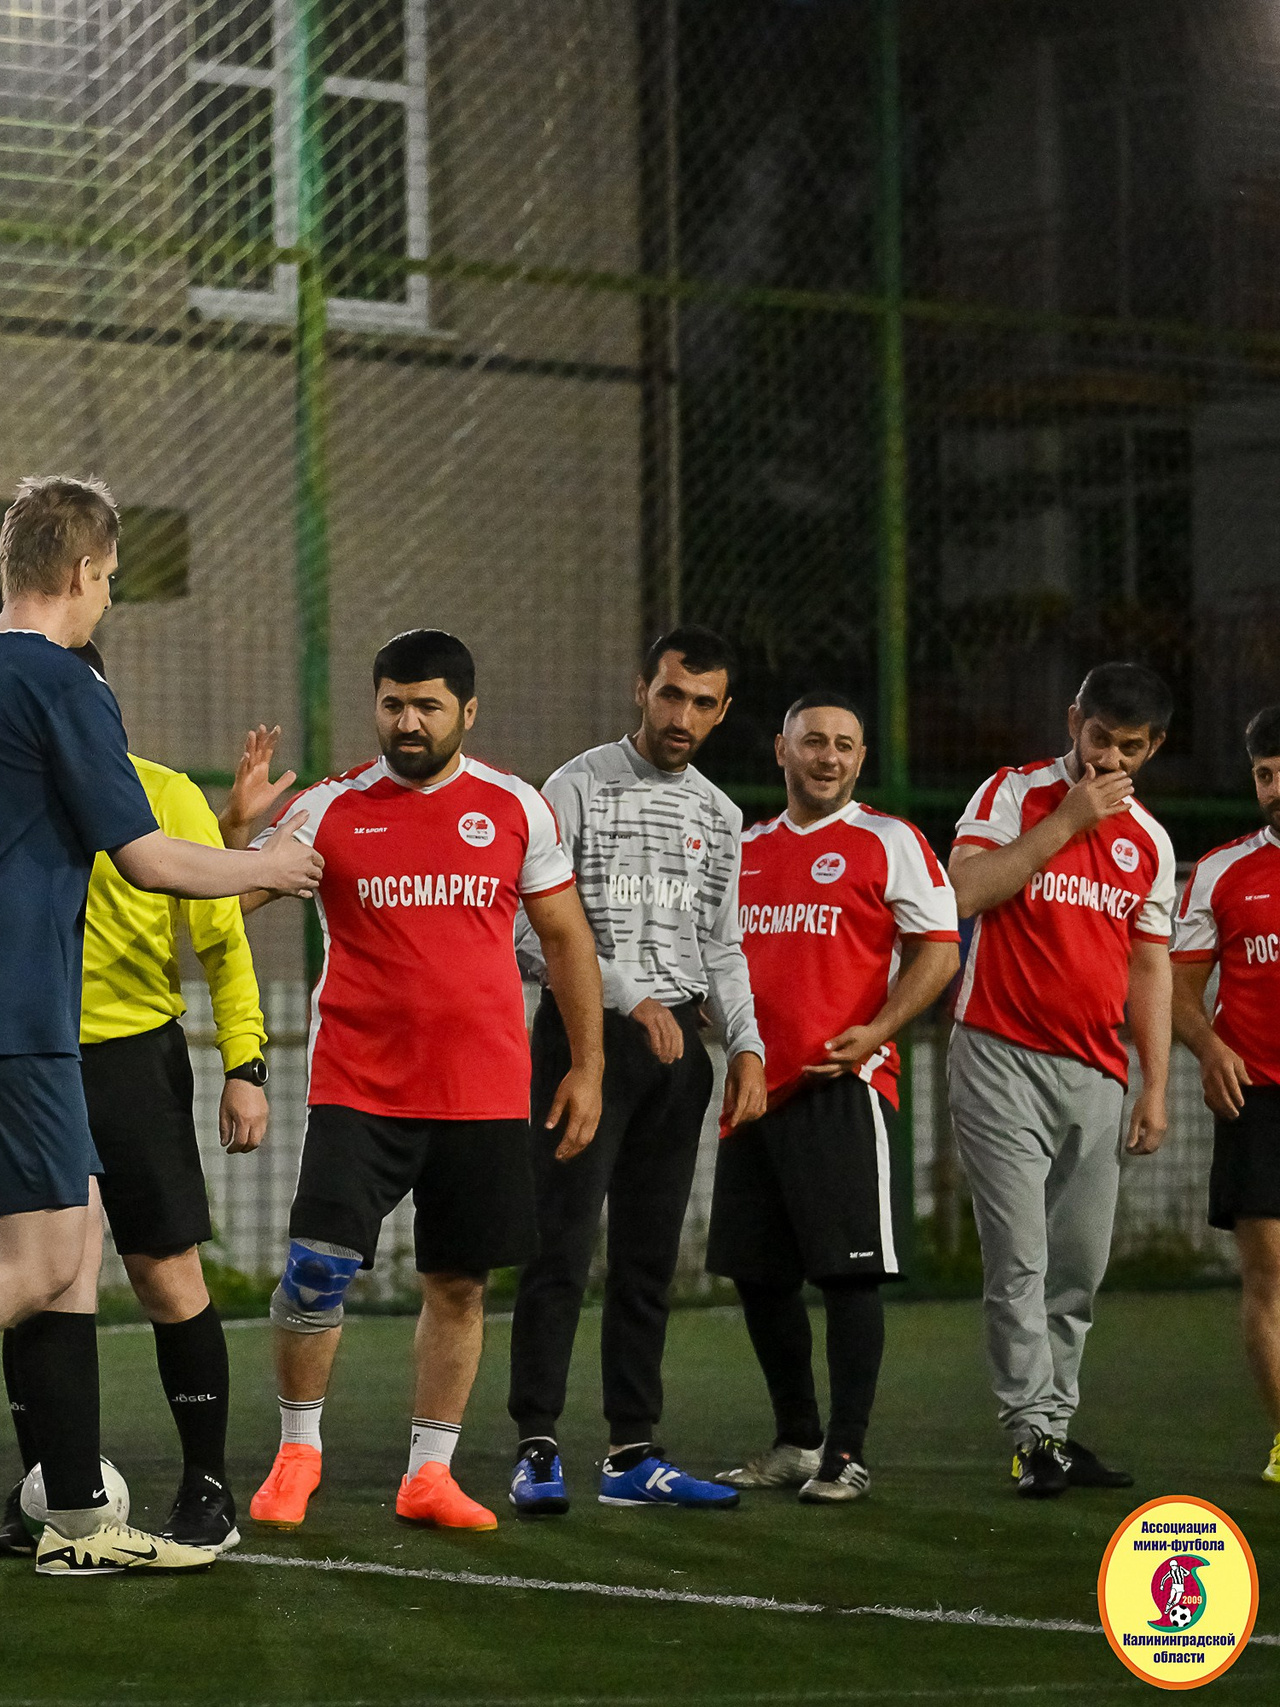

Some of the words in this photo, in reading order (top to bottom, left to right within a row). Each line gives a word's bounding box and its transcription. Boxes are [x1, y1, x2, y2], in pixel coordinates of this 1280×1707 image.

[357, 874, 500, 908] РОССМАРКЕТ
[1030, 871, 1141, 920] РОССМАРКЕТ
[739, 903, 843, 937] ОССМАРКЕТ
